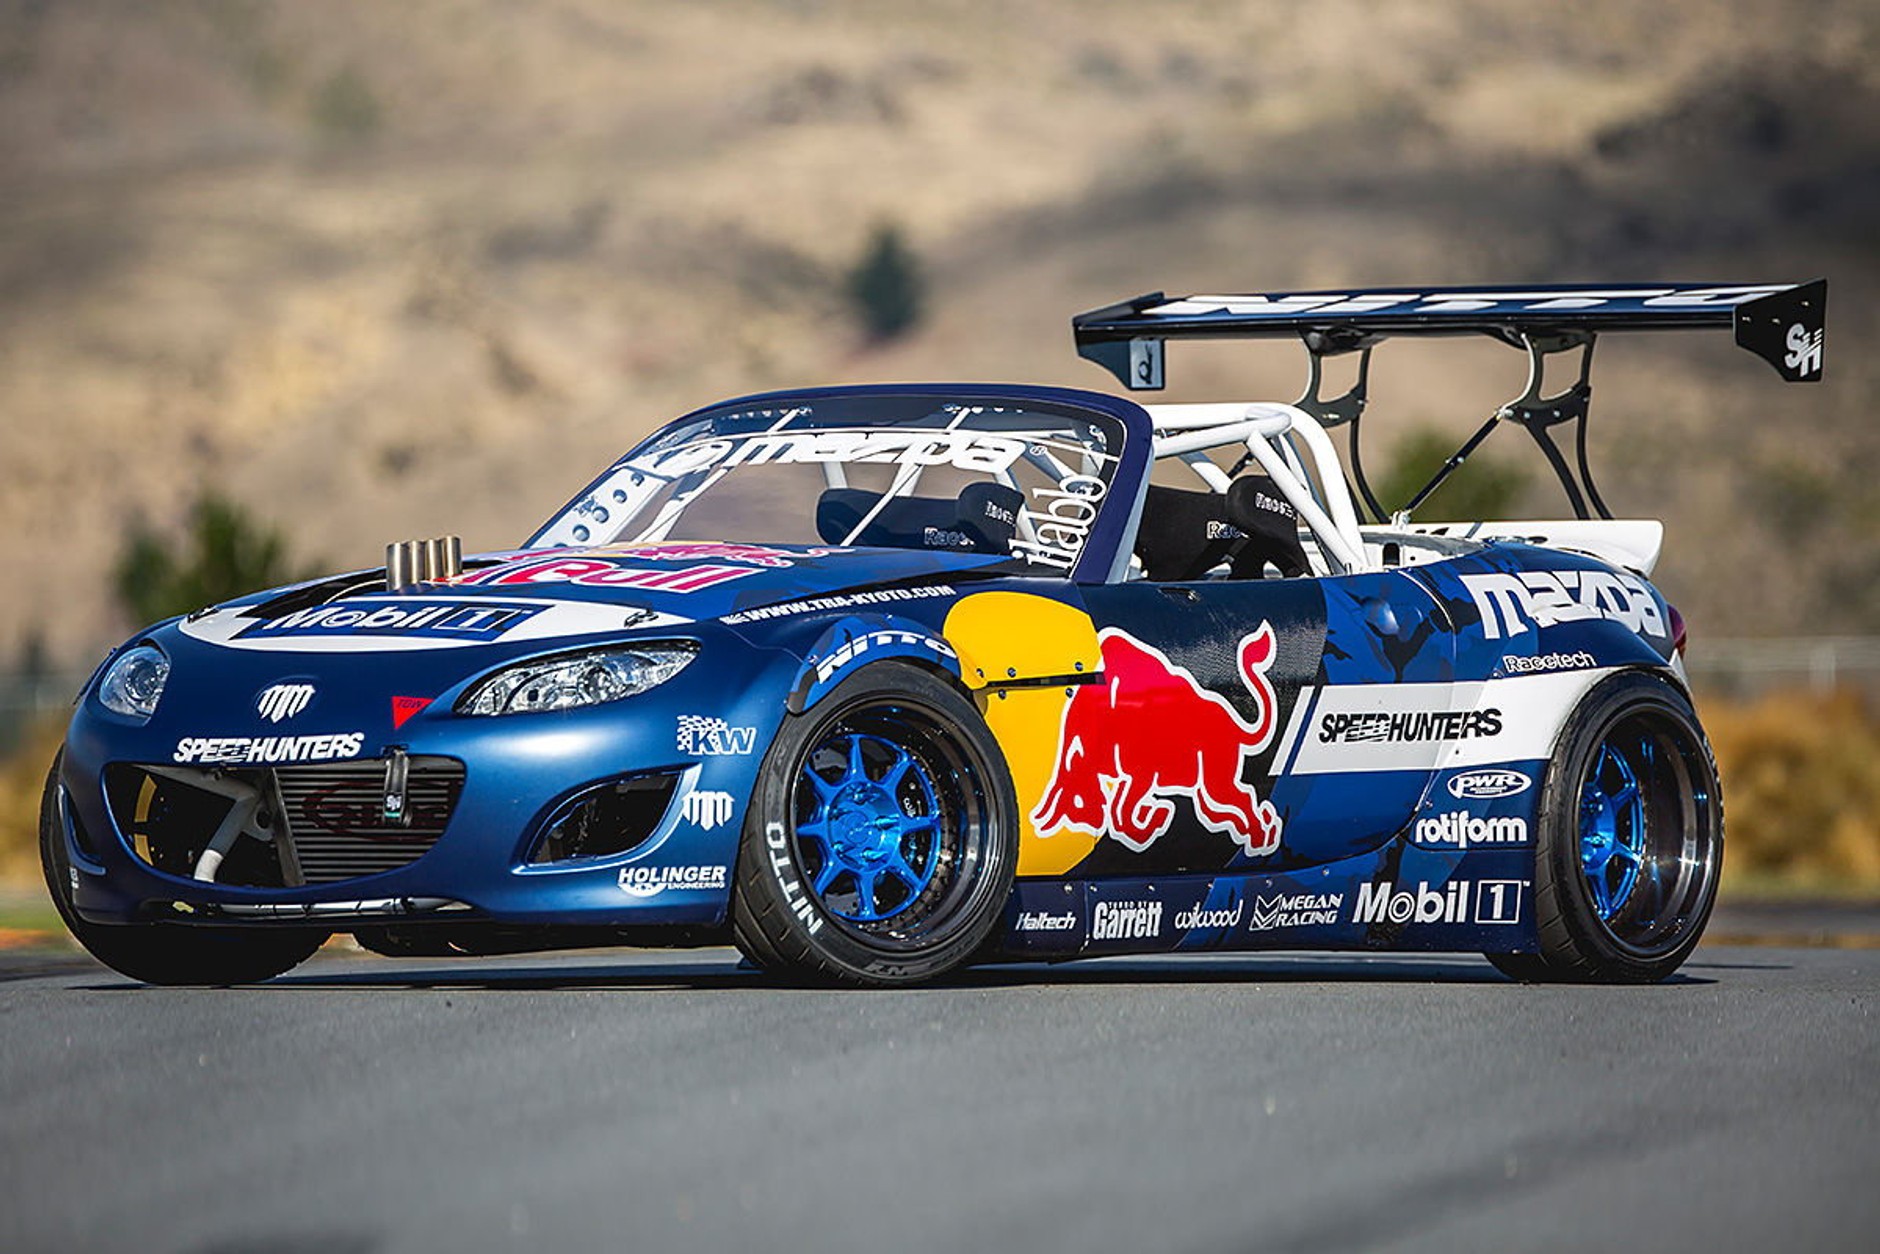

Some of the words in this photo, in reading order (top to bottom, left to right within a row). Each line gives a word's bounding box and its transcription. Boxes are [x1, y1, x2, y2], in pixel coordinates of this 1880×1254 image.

[261, 604, 448, 630] Mobil
[745, 584, 958, 622] WWW.TRA-KYOTO.COM
[1459, 570, 1667, 640] mazda
[1503, 650, 1597, 674] Racetech
[1319, 707, 1503, 743] SPEEDHUNTERS
[173, 733, 365, 763] SPEEDHUNTERS
[687, 727, 757, 756] KW
[1415, 810, 1528, 849] rotiform
[618, 865, 727, 883] HOLINGER
[766, 820, 824, 936] NITTO
[1280, 893, 1344, 911] MEGAN
[1352, 880, 1470, 924] Mobil
[1015, 911, 1077, 932] Haltech
[1092, 901, 1163, 940] Garrett
[1275, 910, 1338, 928] RACING
